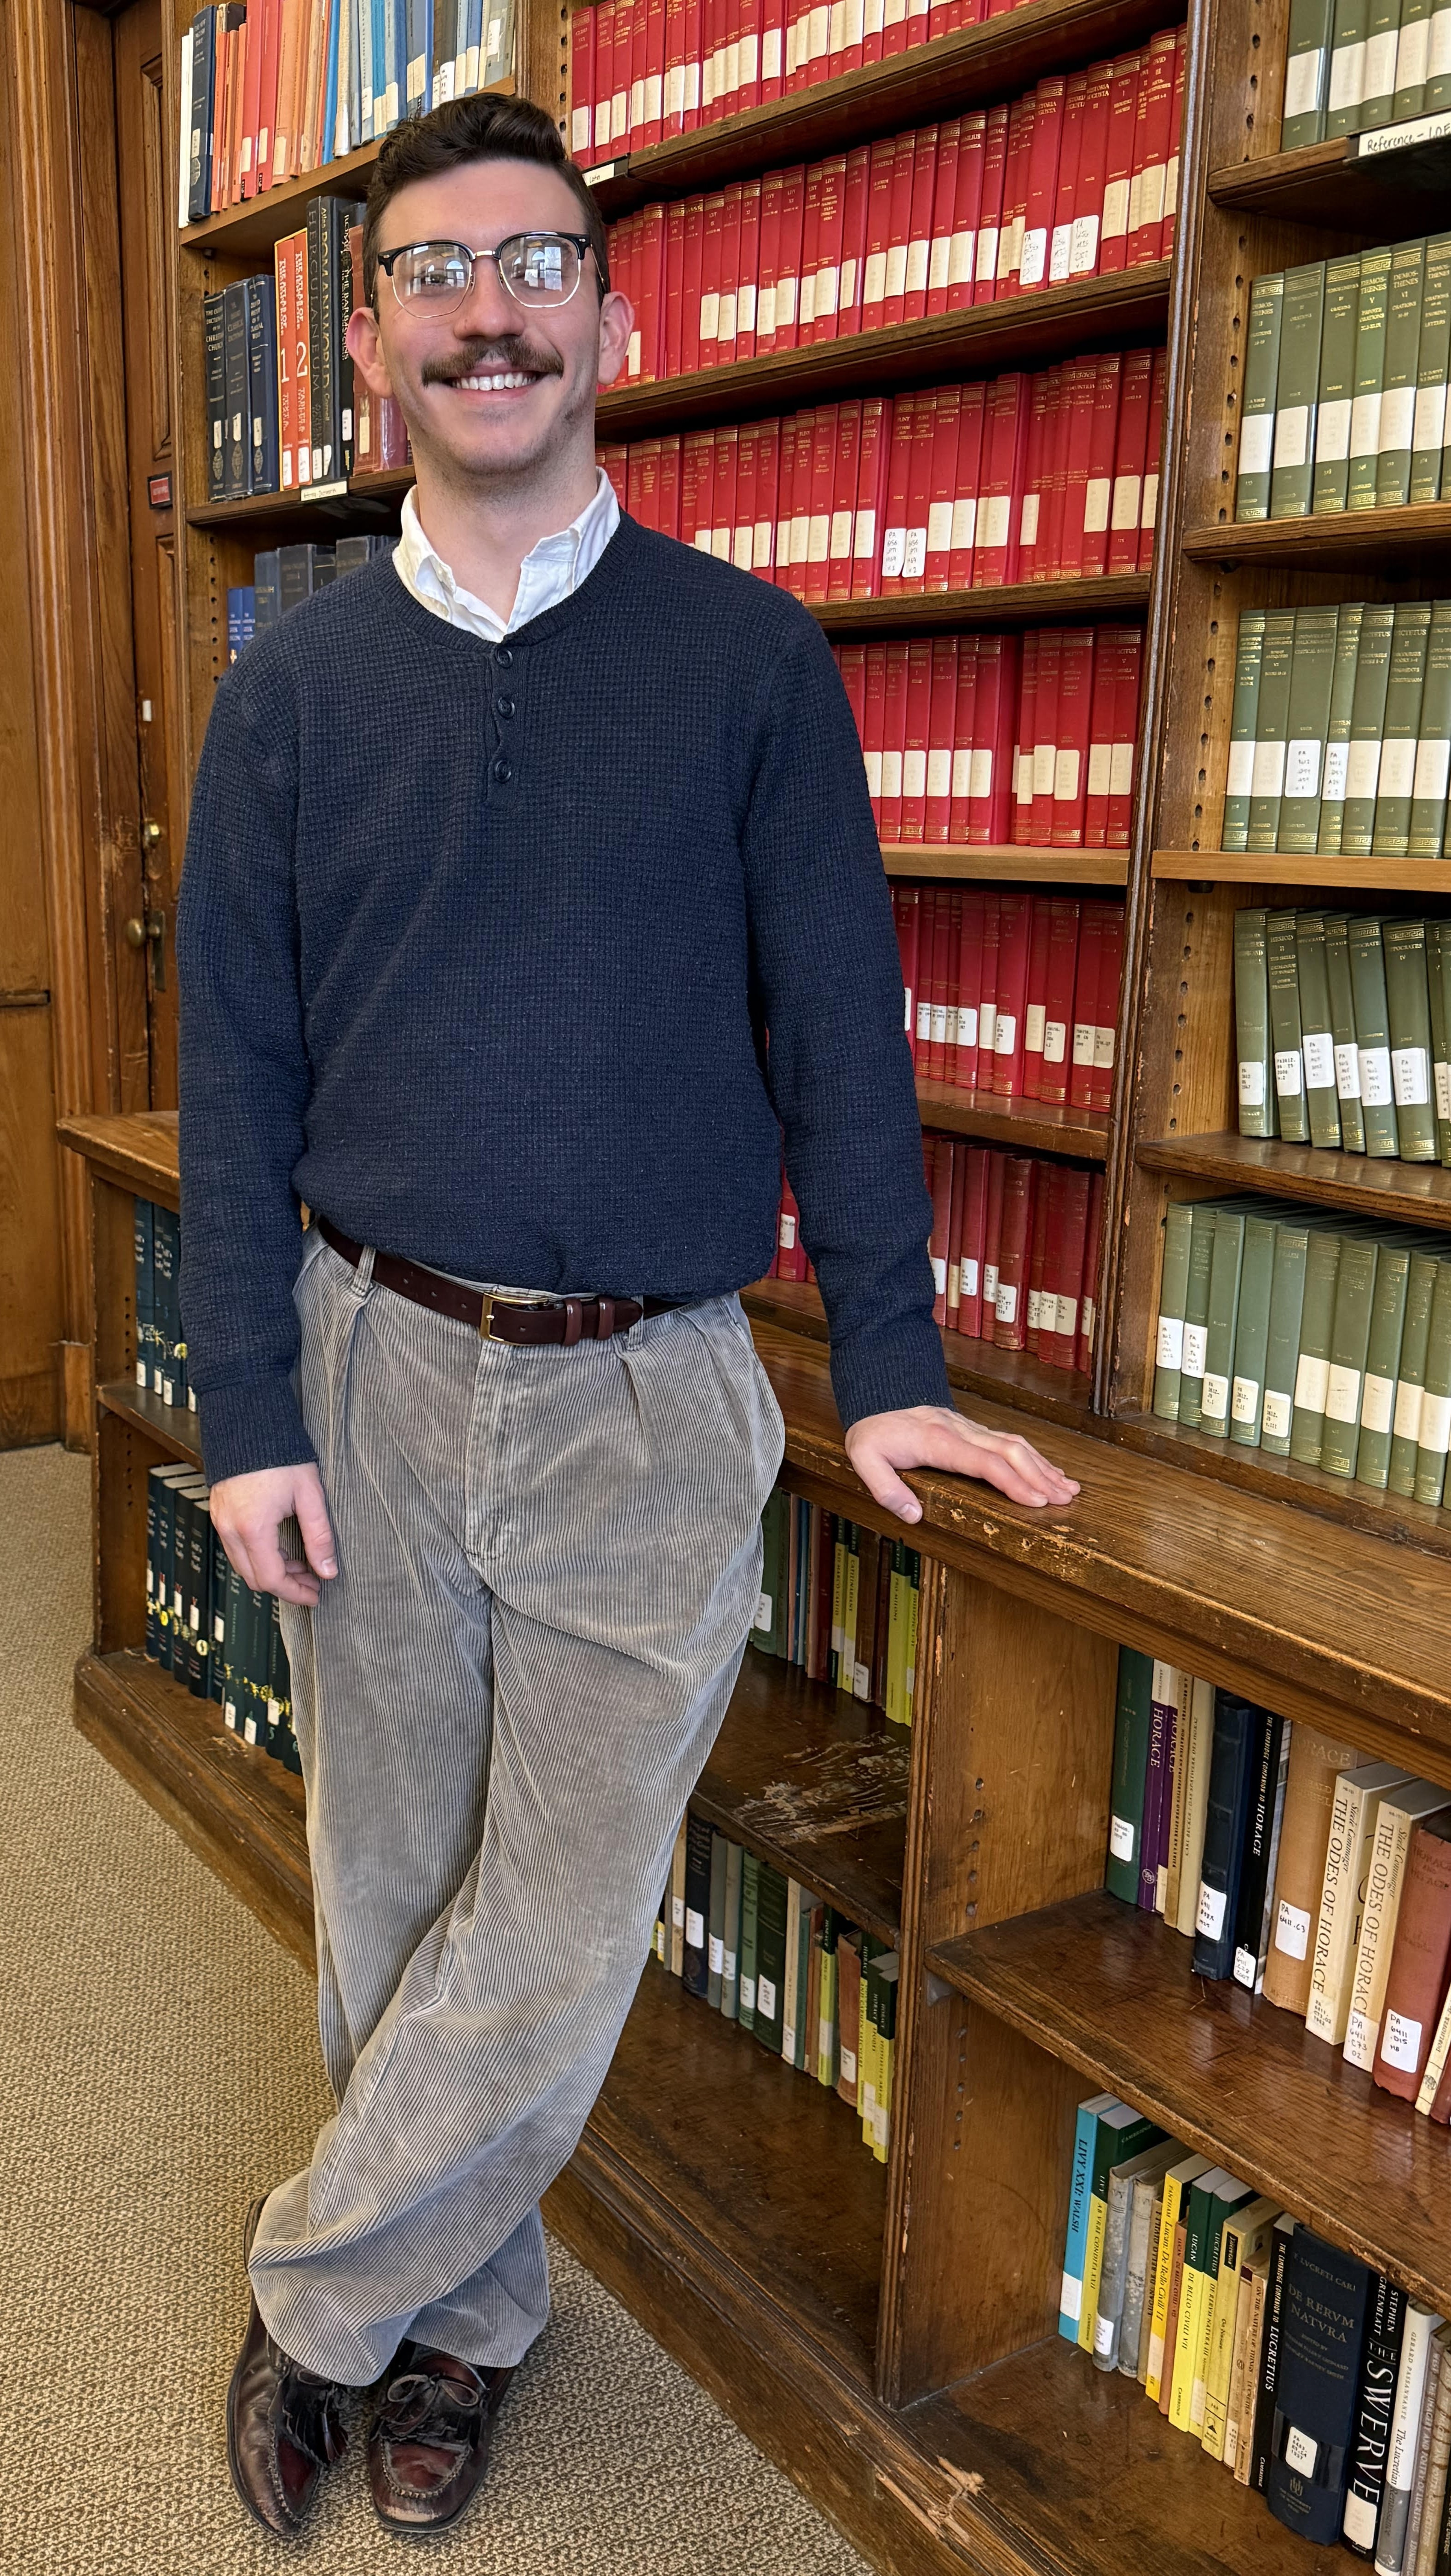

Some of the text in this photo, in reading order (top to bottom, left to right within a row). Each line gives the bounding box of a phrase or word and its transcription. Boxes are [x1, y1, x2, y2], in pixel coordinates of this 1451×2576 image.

[1368, 135, 1414, 152] Reference
[1361, 276, 1387, 287] DEMOS-
[1361, 283, 1387, 294] THENES
[1393, 270, 1418, 281] DEMOS-
[1393, 277, 1418, 288] THENES
[1428, 270, 1450, 279] THENES
[308, 211, 320, 392] HERCULANEUM
[1392, 301, 1416, 310] ORATIONS
[281, 348, 289, 383] 1
[297, 342, 308, 378] 2
[1151, 1708, 1163, 1768] HORACE
[1263, 1728, 1272, 1758] CAMBRIDGE
[1260, 1761, 1269, 1792] COMPANION
[1252, 1803, 1265, 1856] HORACE
[1203, 1891, 1210, 1900] PA
[1313, 1799, 1347, 1995] THE ODES OF HORACE
[1365, 1823, 1394, 1942] THE ODES OF
[1281, 1903, 1290, 1915] PA
[1351, 2016, 1363, 2029] PA
[1390, 2013, 1400, 2025] PA
[1391, 2025, 1407, 2038] 6411
[1349, 2028, 1365, 2041] 6411
[1077, 2139, 1088, 2168] LIVY
[1096, 2202, 1102, 2213] AB
[1164, 2185, 1175, 2217] FANTHAM
[1071, 2199, 1081, 2233] WALSH
[1152, 2218, 1161, 2244] CIVILI
[1161, 2221, 1172, 2249] Lucan:
[1091, 2236, 1100, 2270] CONDITA
[1161, 2251, 1169, 2263] De
[1190, 2233, 1198, 2262] LUCAN
[1212, 2232, 1221, 2271] LUCRETIUS
[1150, 2274, 1156, 2284] DE
[1158, 2265, 1168, 2286] Bello
[1188, 2272, 1194, 2281] DE
[1276, 2255, 1285, 2284] CAMBRIDGE
[1300, 2258, 1356, 2292] LVCRETI CARI
[1255, 2286, 1262, 2297] ON
[1273, 2285, 1282, 2314] COMPANION
[1289, 2283, 1354, 2329] DE RERVM
[1374, 2276, 1387, 2336] GREENBLATT
[1155, 2311, 1163, 2321] II
[1251, 2312, 1260, 2336] NATURE
[1291, 2303, 1347, 2343] NATVRA
[1387, 2290, 1398, 2332] STEPHEN
[1247, 2350, 1255, 2372] THINGS
[1265, 2326, 1279, 2392] LUCRETIUS
[1399, 2332, 1417, 2420] GERARD PASSANNANTE
[1428, 2382, 1436, 2396] THE
[1424, 2397, 1434, 2430] IMAGERY
[1353, 2360, 1393, 2502] SWERVE
[1421, 2433, 1430, 2450] AND
[1417, 2451, 1428, 2480] POETRY
[1383, 2429, 1406, 2536] The Lucretian Renaissance
[1416, 2482, 1424, 2492] OF
[1411, 2493, 1422, 2532] LUCRETIUS
